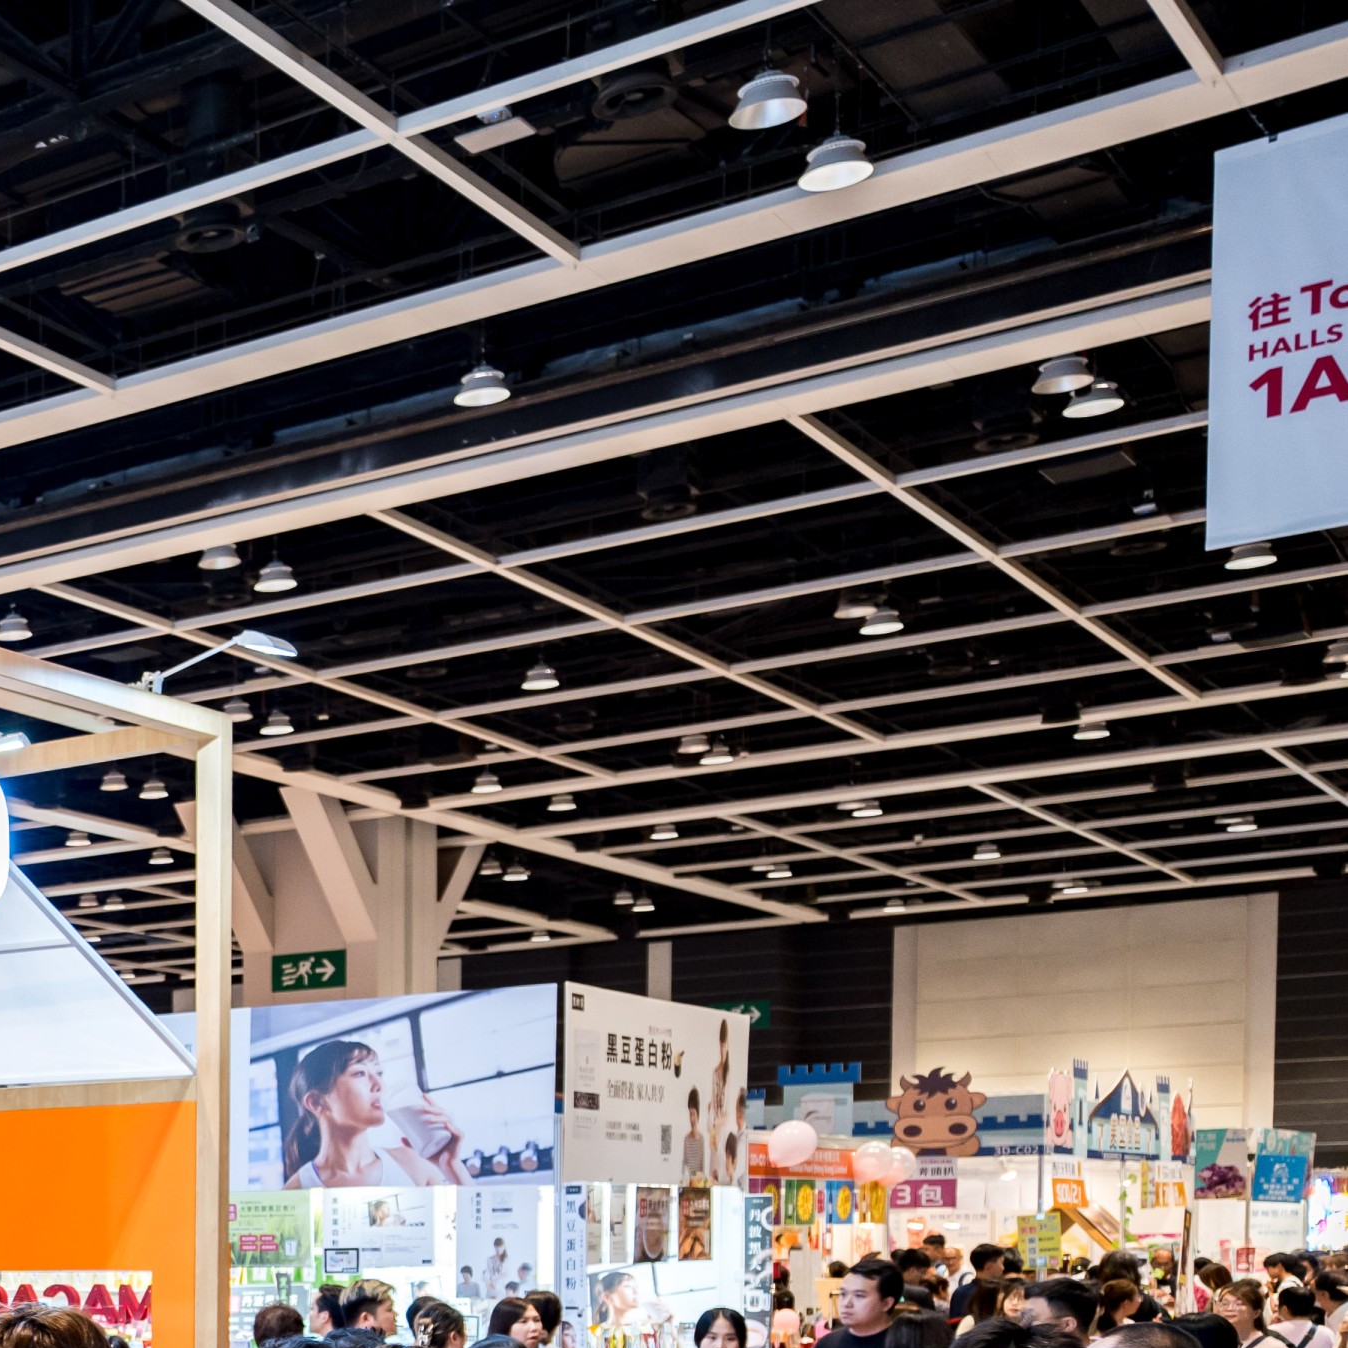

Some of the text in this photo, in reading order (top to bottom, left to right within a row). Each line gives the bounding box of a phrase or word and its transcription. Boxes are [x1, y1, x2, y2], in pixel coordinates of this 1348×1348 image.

[1248, 292, 1291, 331] 往
[1248, 323, 1343, 361] HALLS
[607, 1033, 672, 1071] 黑豆蛋白粉
